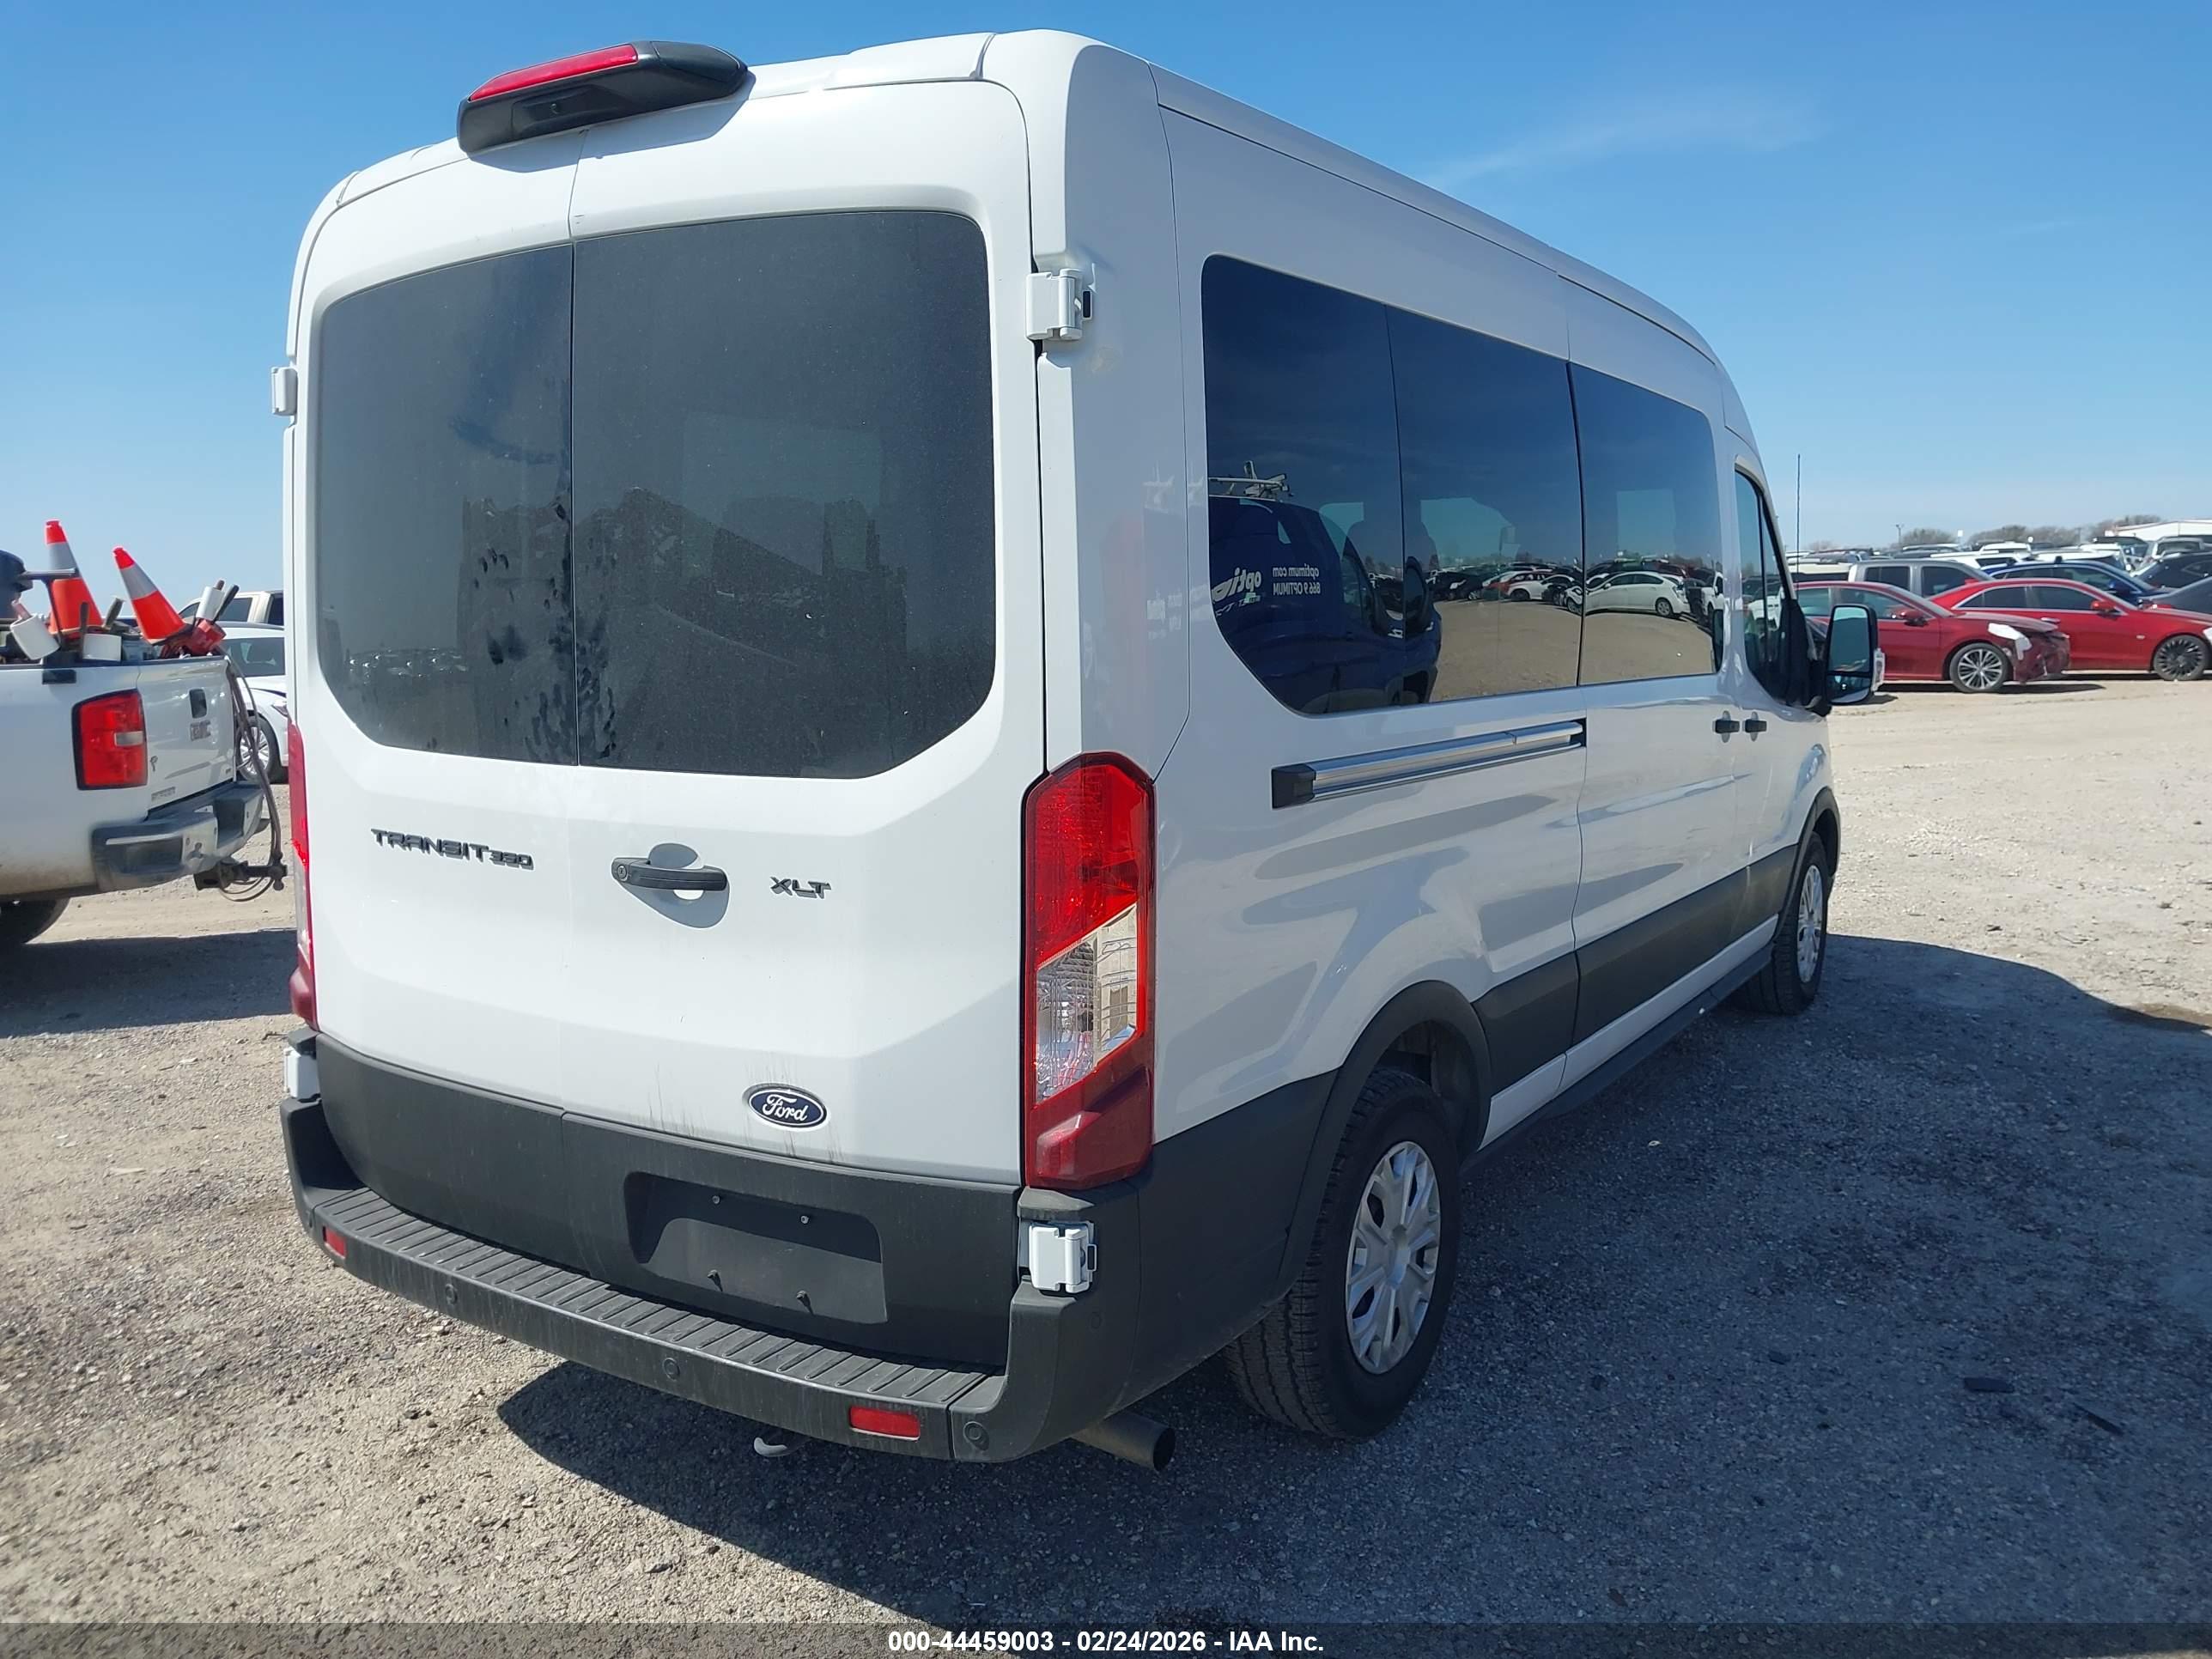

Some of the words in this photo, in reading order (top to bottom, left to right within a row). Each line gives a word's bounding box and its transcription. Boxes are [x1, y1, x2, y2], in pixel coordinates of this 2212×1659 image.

[370, 828, 489, 863] TRANSIT
[489, 849, 534, 871] 350
[769, 876, 832, 900] XLT
[762, 1093, 809, 1121] Ford
